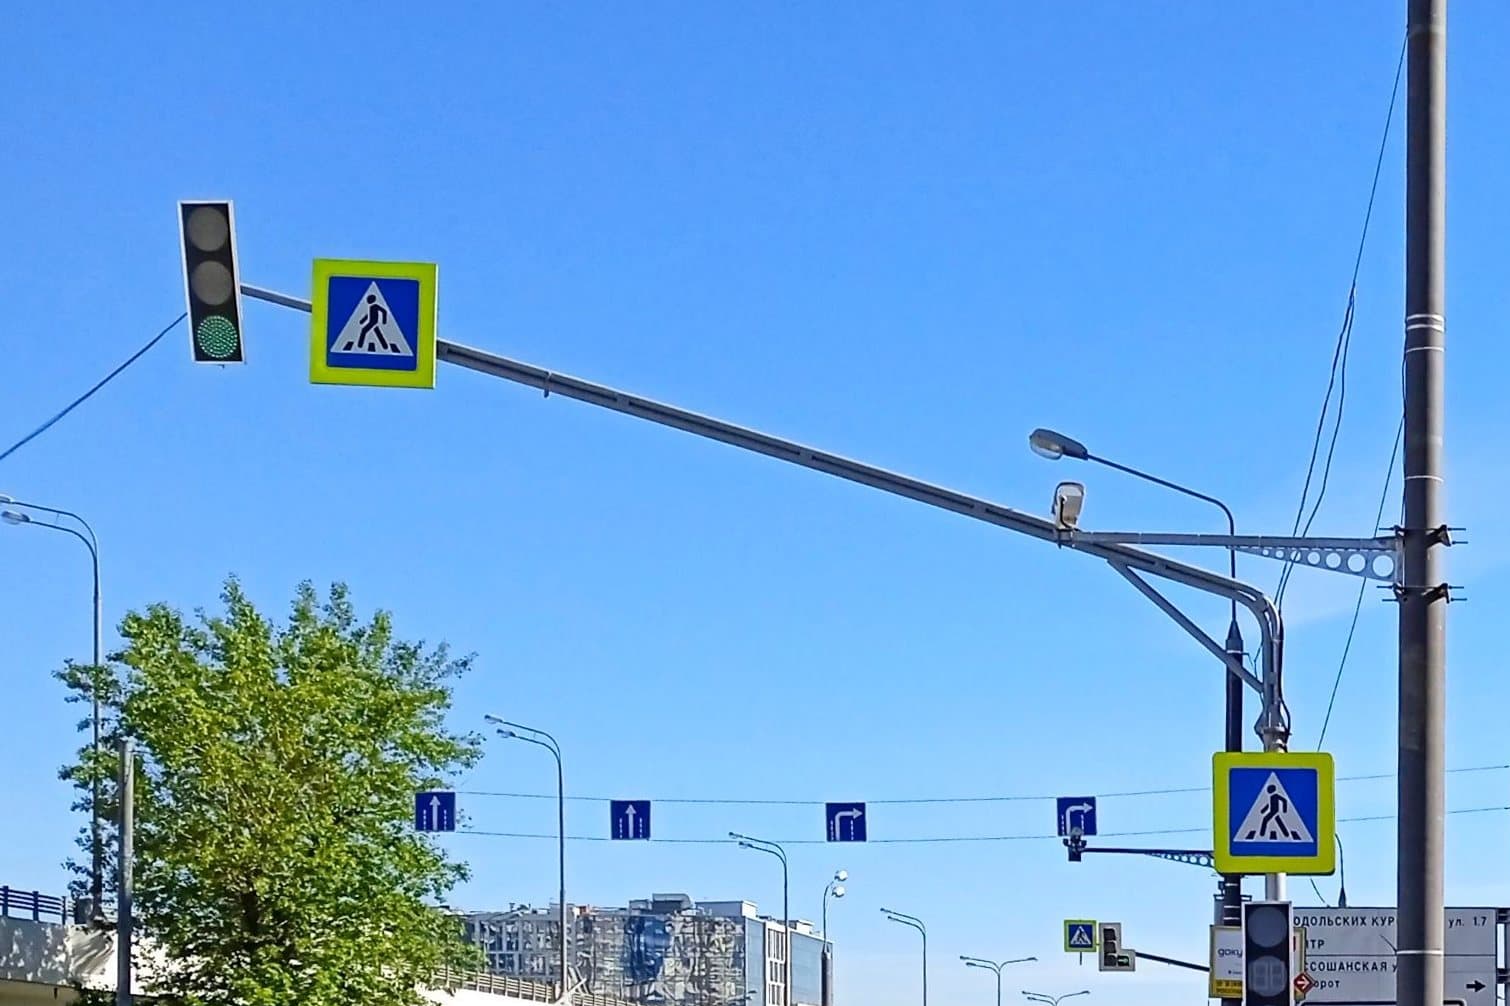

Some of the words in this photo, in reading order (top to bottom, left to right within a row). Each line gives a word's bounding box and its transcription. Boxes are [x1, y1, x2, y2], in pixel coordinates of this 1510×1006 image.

[1292, 916, 1367, 927] ОДОЛЬСКИХ
[1371, 916, 1396, 926] КУР
[1448, 918, 1465, 929] ул.
[1304, 961, 1388, 972] СОШАНСКАЯ
[1313, 980, 1340, 990] орот
